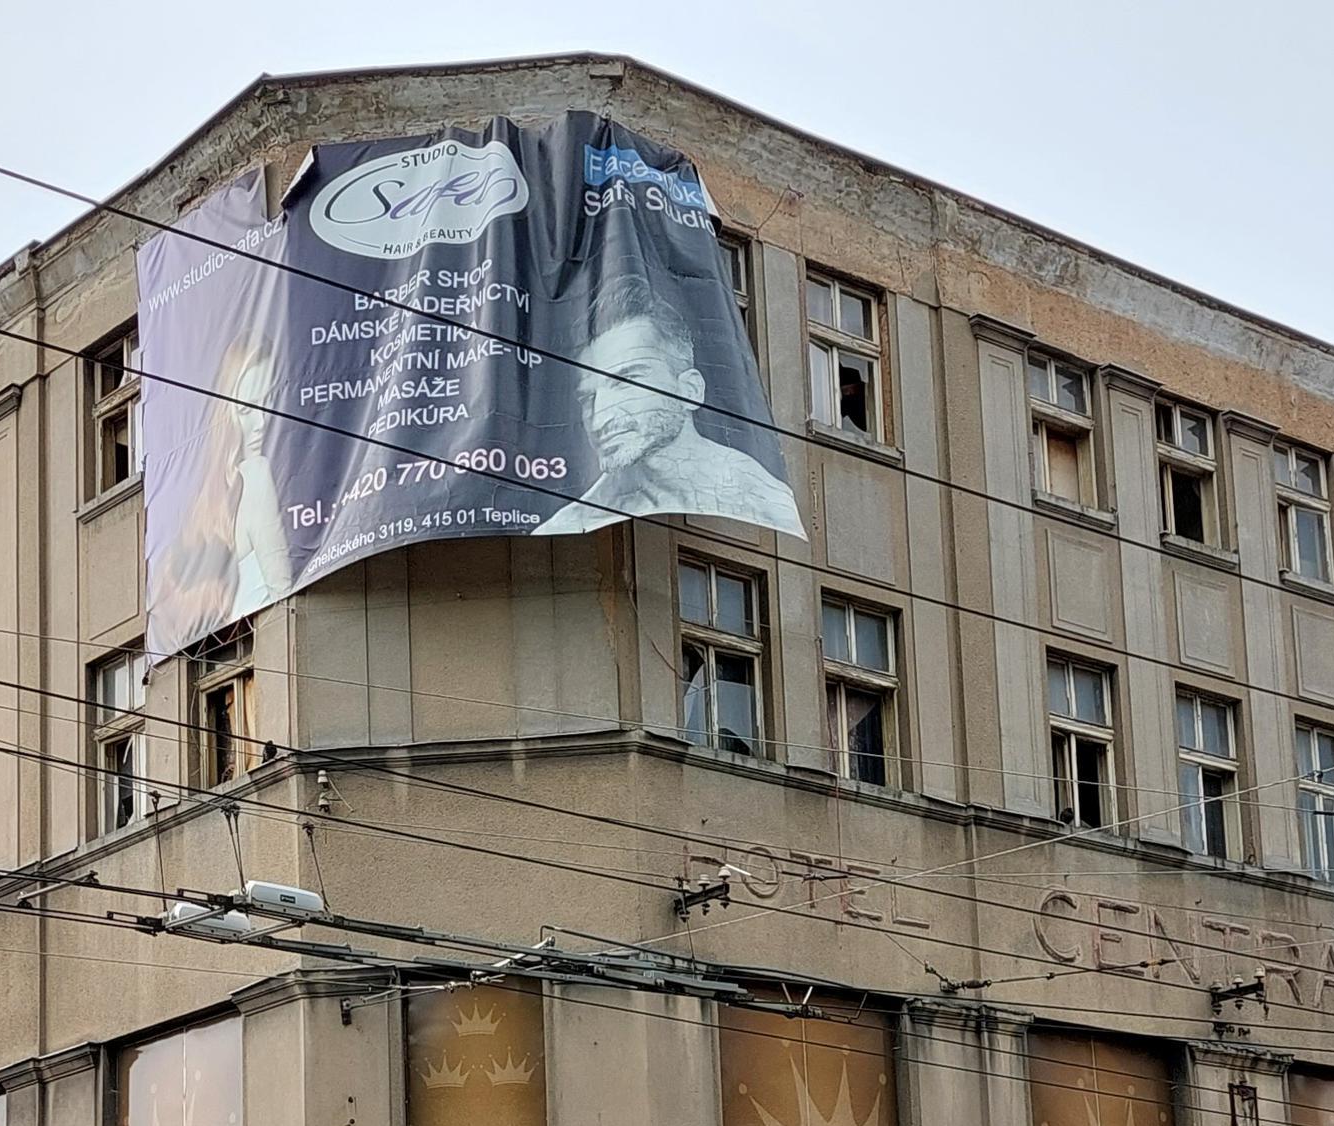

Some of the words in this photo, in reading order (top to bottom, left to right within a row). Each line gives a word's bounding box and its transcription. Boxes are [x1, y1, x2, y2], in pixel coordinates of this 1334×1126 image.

[401, 144, 458, 168] STUDIO
[584, 179, 637, 217] Safa
[646, 187, 717, 238] Studio
[383, 243, 413, 255] HAIR
[423, 228, 473, 242] BEAUTY
[354, 269, 432, 312] BARBER
[437, 259, 492, 289] SHOP
[311, 310, 400, 345] DÁMSKÉ
[370, 321, 479, 366] KOSMETIKA
[300, 348, 440, 406] PERMANENTNÍ
[376, 376, 461, 411] MASÁŽE
[367, 403, 469, 439] PEDIKÚRA
[287, 499, 336, 530] Tel.:
[341, 467, 387, 506] +420
[396, 460, 446, 486] 770
[454, 448, 506, 475] 660
[515, 453, 567, 480] 063
[378, 517, 417, 541] 3119,
[421, 512, 452, 529] 415
[456, 508, 476, 524] 01
[481, 507, 540, 526] Teplice
